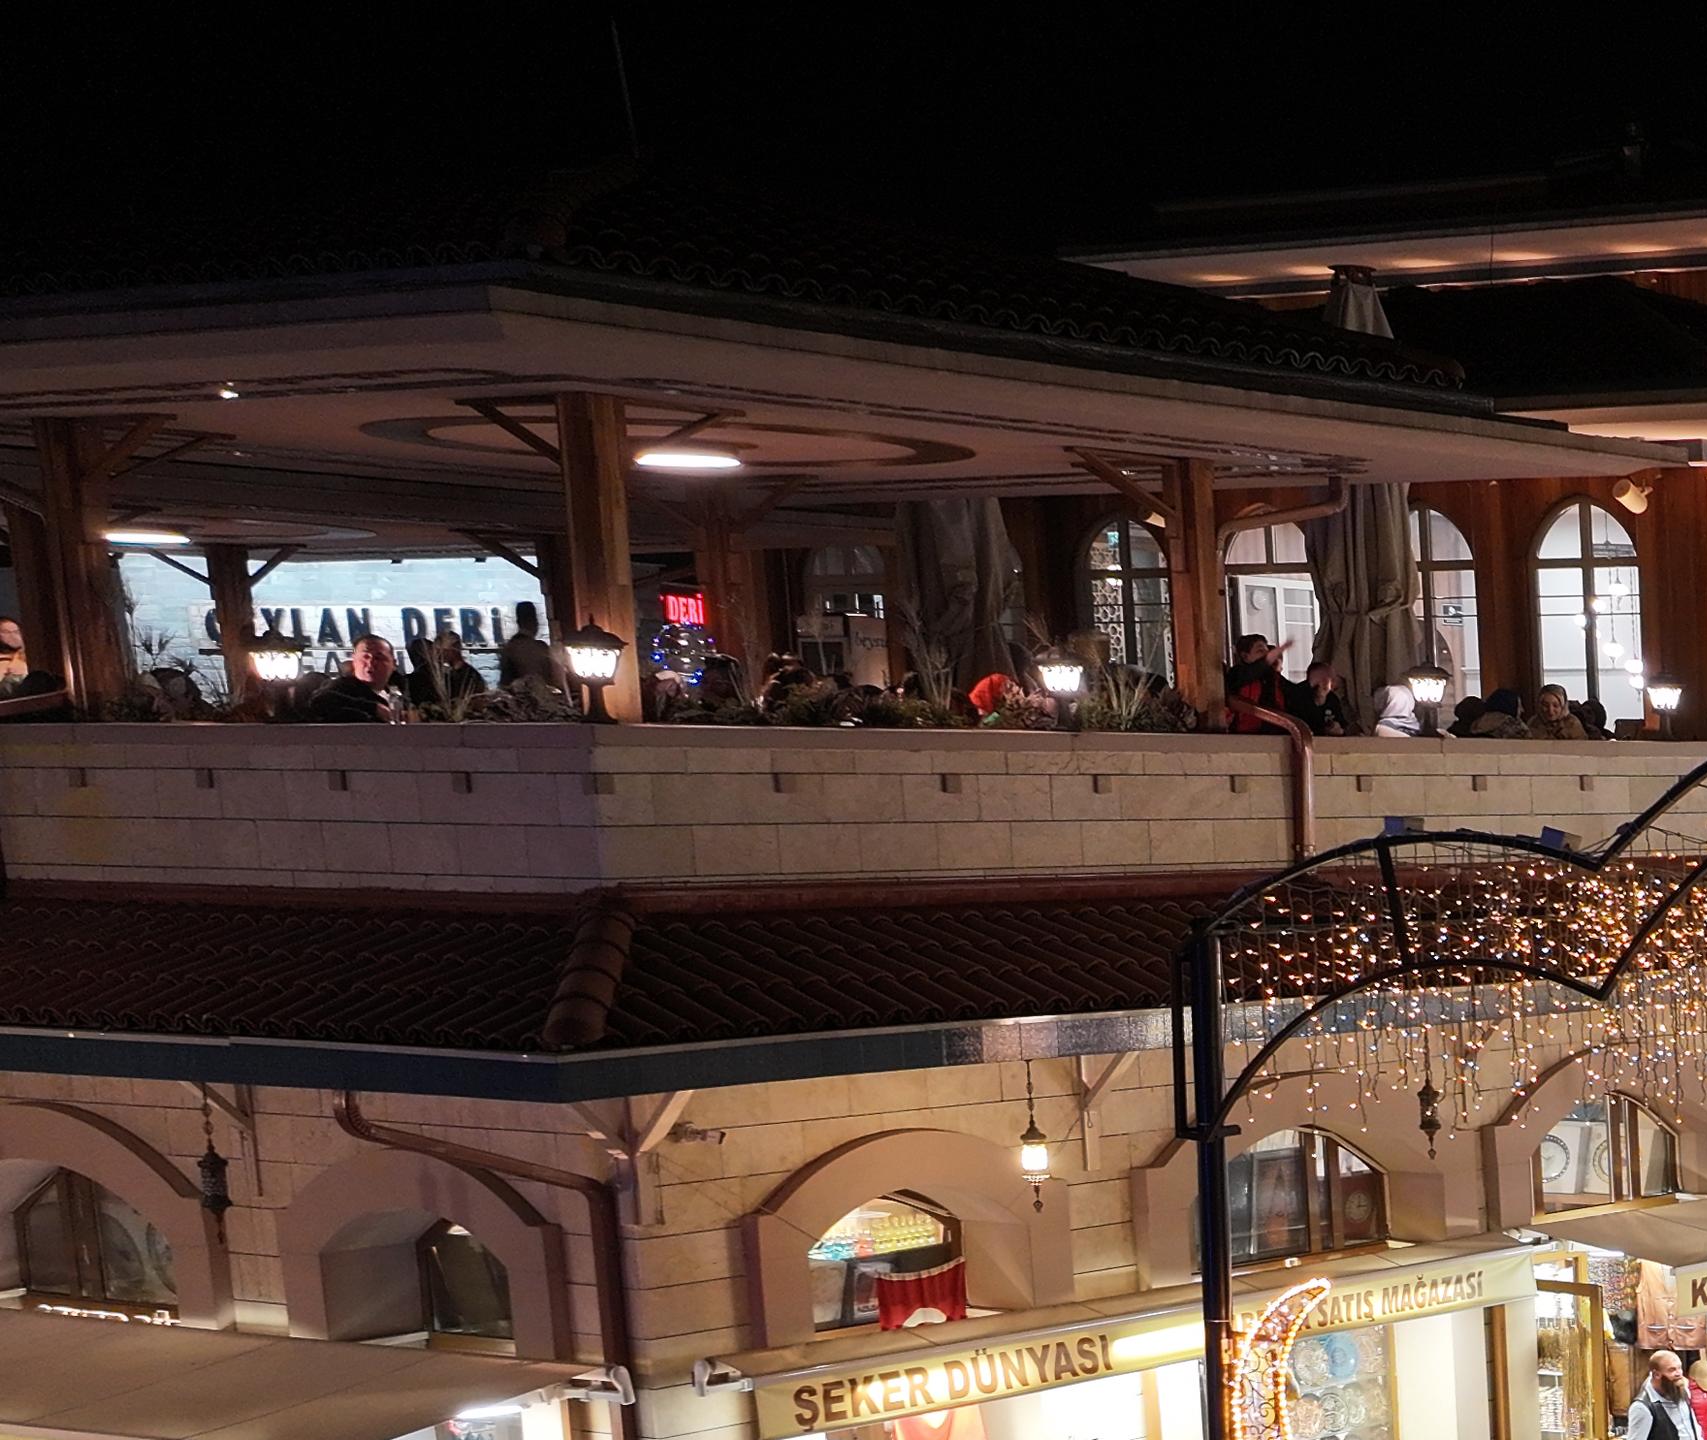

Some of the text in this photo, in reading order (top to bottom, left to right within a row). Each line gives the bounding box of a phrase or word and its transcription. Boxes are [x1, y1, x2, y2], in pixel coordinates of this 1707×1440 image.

[204, 606, 377, 644] CYLAN
[1317, 1290, 1376, 1329] SATIŞ
[1382, 1271, 1484, 1316] MAĞAZASI
[793, 1334, 1114, 1432] ŞEKER DÜNYASI
